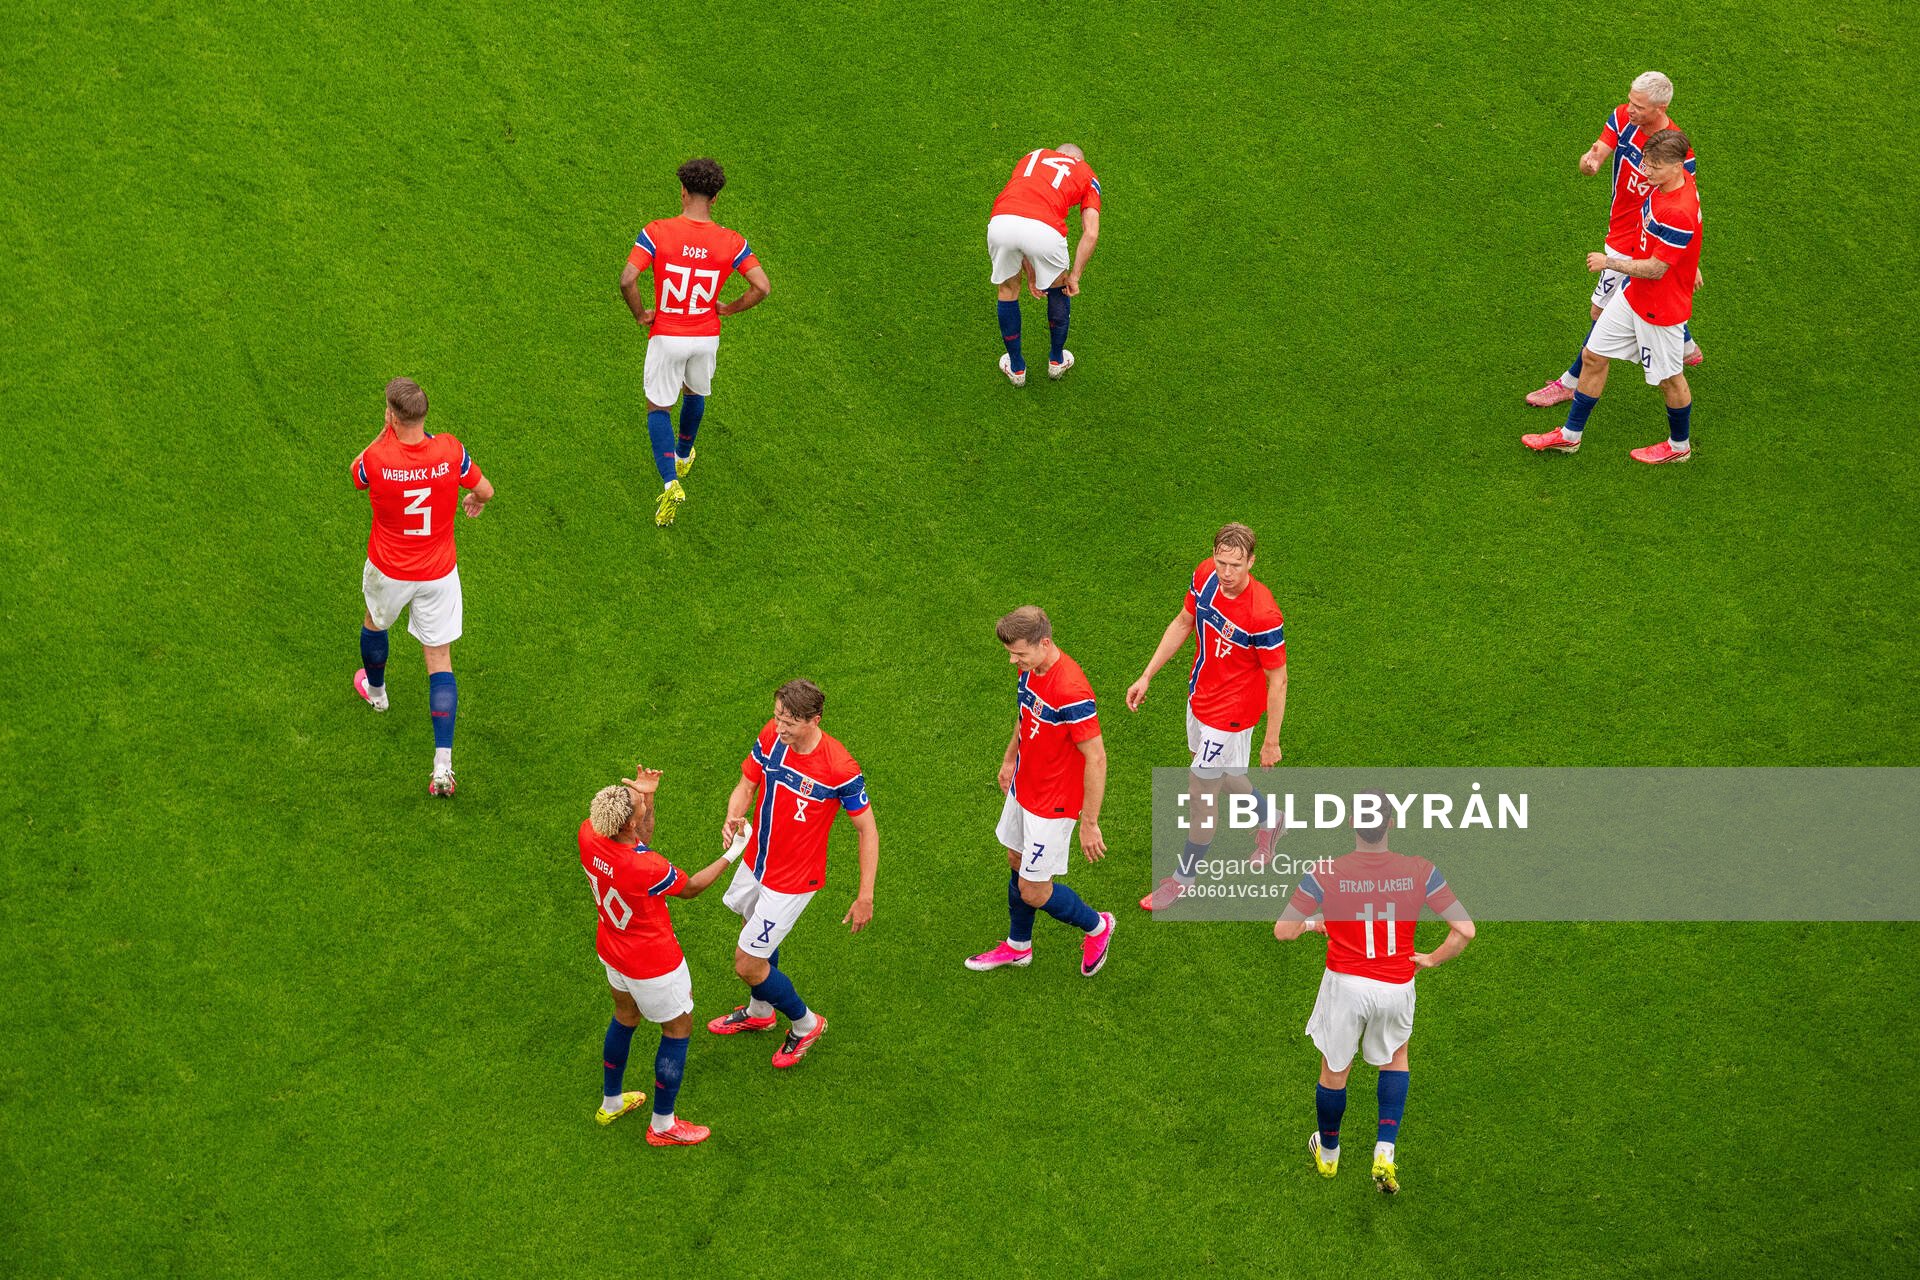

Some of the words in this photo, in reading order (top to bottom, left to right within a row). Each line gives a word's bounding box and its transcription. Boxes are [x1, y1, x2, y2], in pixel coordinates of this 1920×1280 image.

[1023, 148, 1076, 190] 14
[1626, 171, 1651, 196] 26
[682, 244, 708, 259] BOBB
[659, 262, 721, 315] 22
[1641, 346, 1651, 368] 5
[382, 467, 428, 482] VASSBAKK
[431, 462, 450, 479] AJER
[403, 487, 432, 536] 3
[1214, 636, 1233, 659] 17
[1029, 718, 1040, 740] 7
[1203, 739, 1224, 763] 17
[793, 798, 809, 822] 8
[1030, 842, 1045, 865] 7
[1339, 879, 1375, 893] STRAND
[1377, 877, 1414, 892] LARSEN
[757, 918, 776, 943] 8
[1355, 902, 1397, 959] 11
